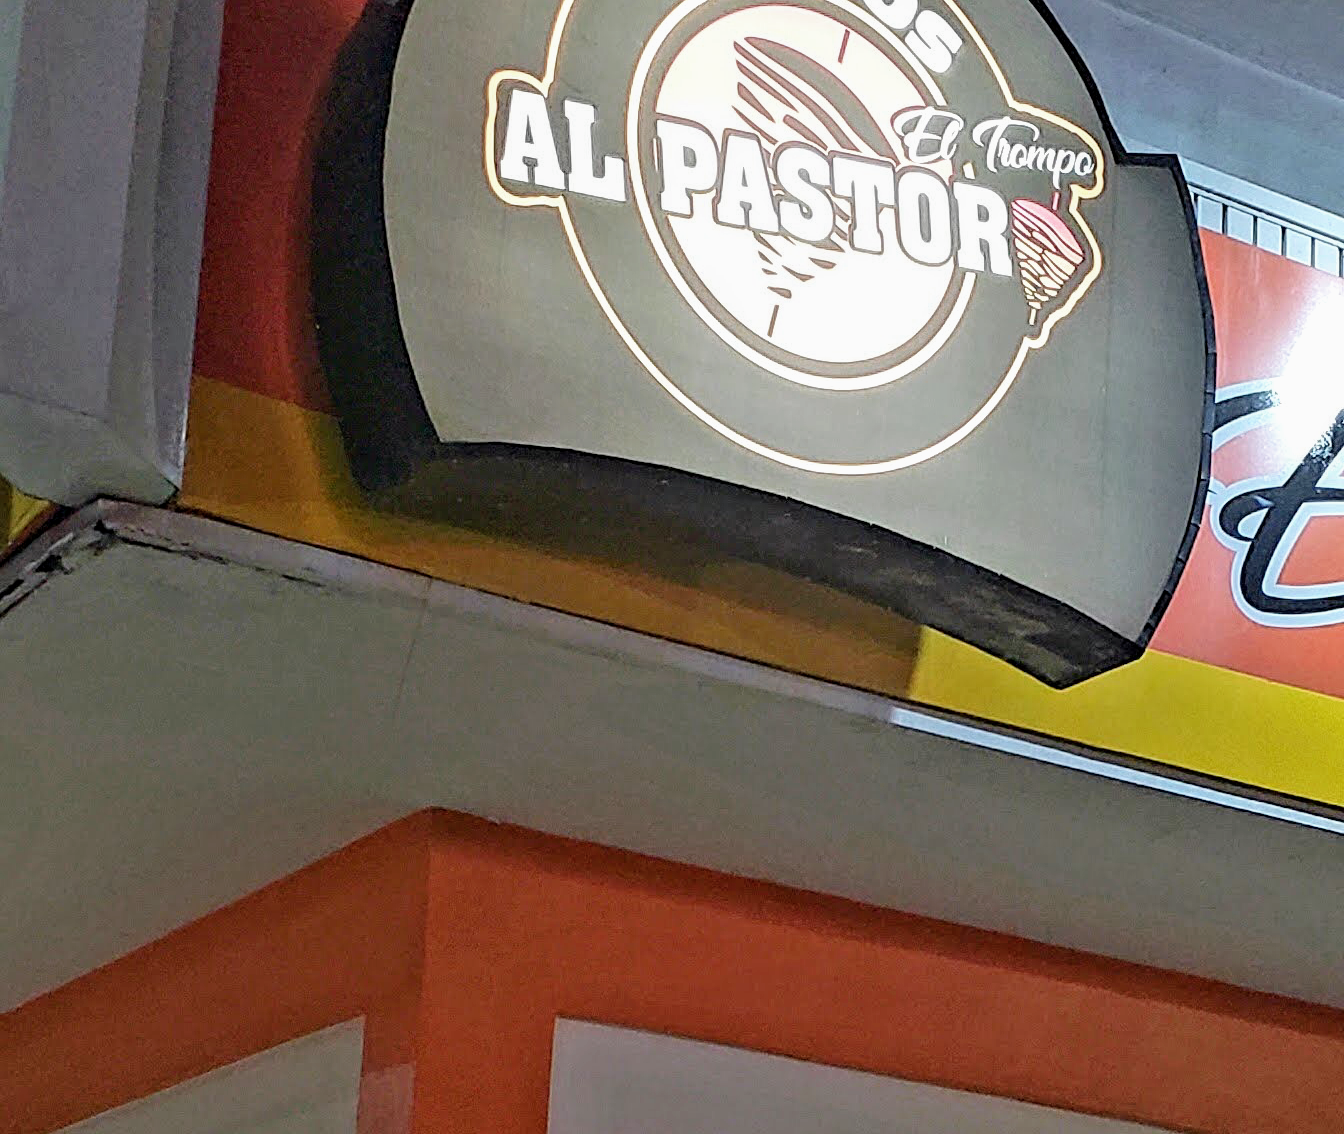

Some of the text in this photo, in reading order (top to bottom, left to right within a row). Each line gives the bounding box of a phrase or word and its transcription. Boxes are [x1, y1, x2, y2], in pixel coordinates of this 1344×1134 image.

[501, 89, 1014, 277] AL PASTOR
[892, 106, 1095, 190] El Trompo
